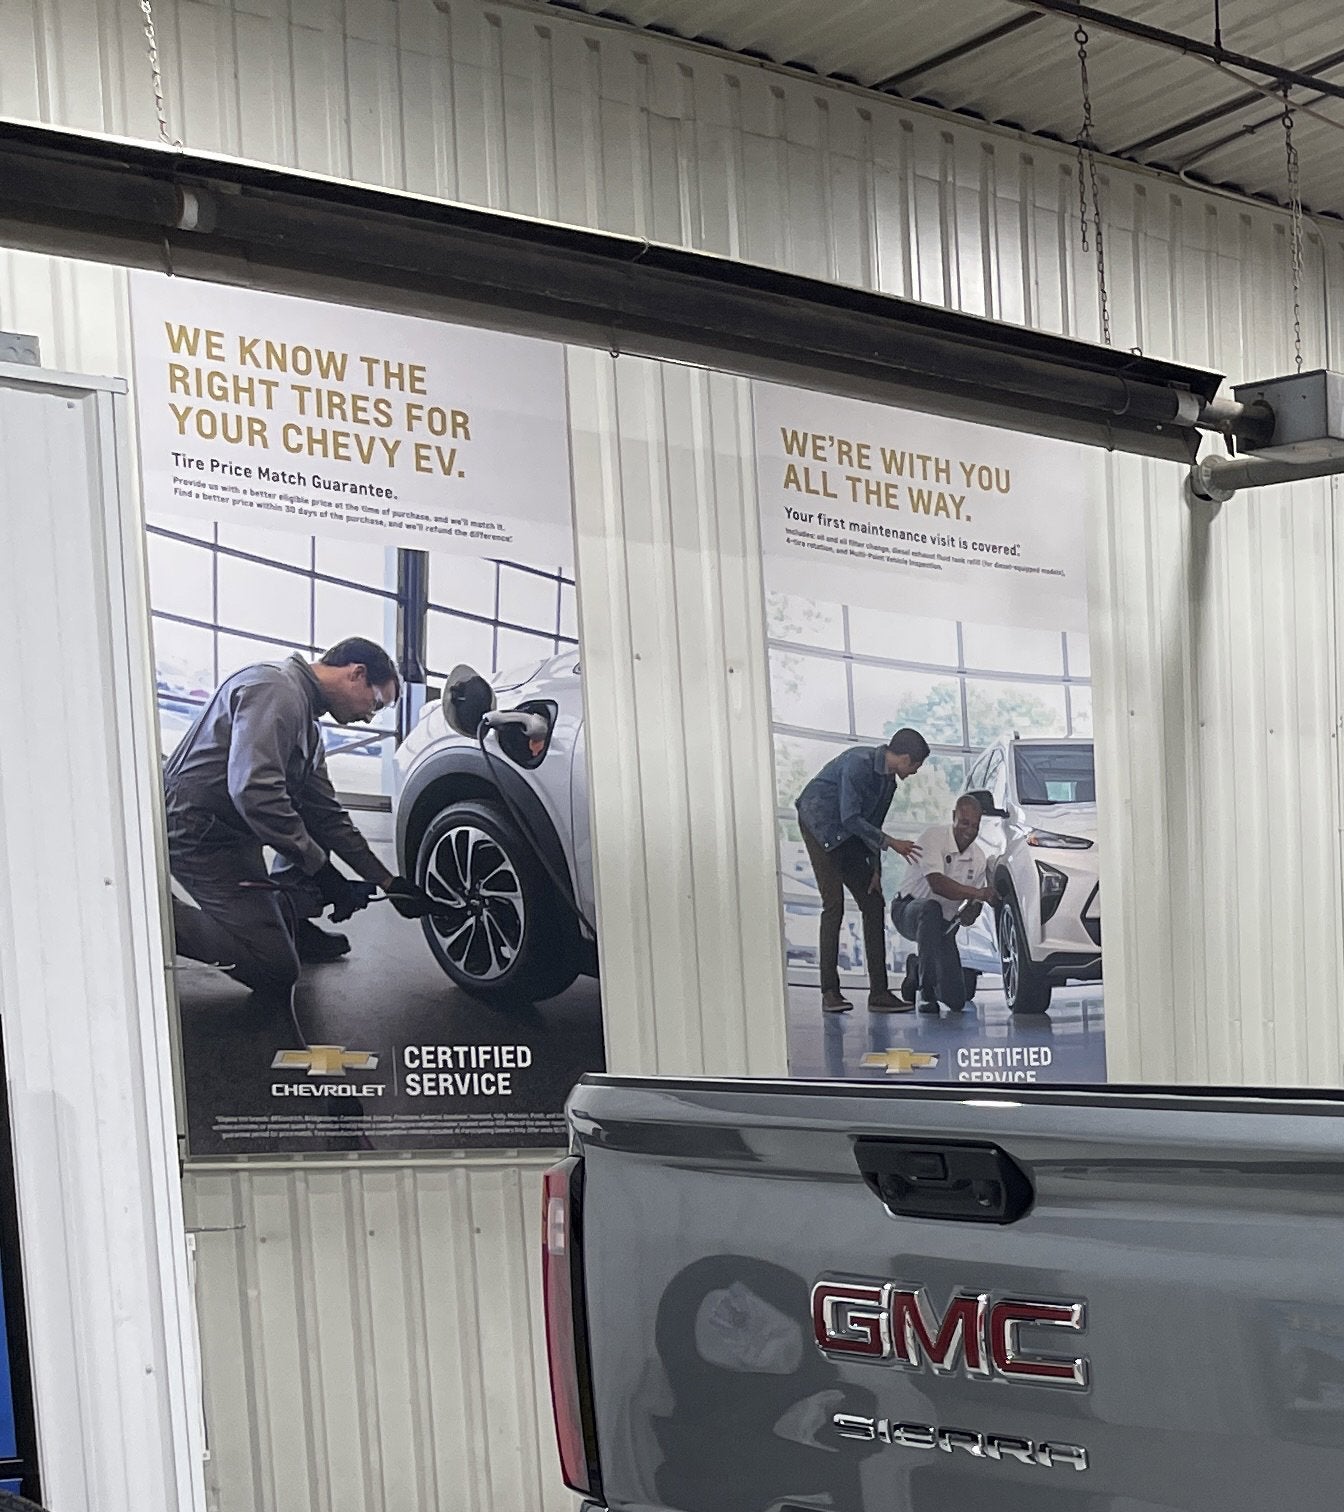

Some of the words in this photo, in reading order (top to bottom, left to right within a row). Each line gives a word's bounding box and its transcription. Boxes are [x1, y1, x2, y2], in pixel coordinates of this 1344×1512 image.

[164, 321, 225, 361] WE
[239, 336, 348, 381] KNOW
[360, 355, 427, 395] THE
[168, 363, 279, 410] RIGHT
[290, 385, 393, 428] TIRES
[405, 403, 471, 440] FOR
[168, 403, 269, 449] YOUR
[283, 423, 401, 467] CHEVY
[414, 444, 466, 478] EV.
[780, 427, 871, 470] WE'RE
[880, 447, 950, 484] WITH
[959, 461, 1011, 493] YOU
[171, 452, 204, 471] Tire
[210, 458, 252, 479] Price
[258, 466, 307, 488] Match
[312, 472, 398, 500] Guarantee.
[784, 463, 838, 499] ALL
[846, 475, 899, 510] THE
[908, 486, 972, 522] WAY.
[784, 506, 814, 523] Your
[817, 512, 845, 529] first
[849, 521, 927, 543] maintenance
[930, 533, 956, 547] visit
[958, 537, 968, 550] is
[404, 1045, 532, 1069] CERTIFIED
[405, 1073, 512, 1096] SERVICE
[957, 1047, 1052, 1067] CERTIFIED
[271, 1083, 386, 1097] CHEVROLET
[810, 1280, 1087, 1387] GMC
[833, 1413, 1090, 1471] SIERRA
